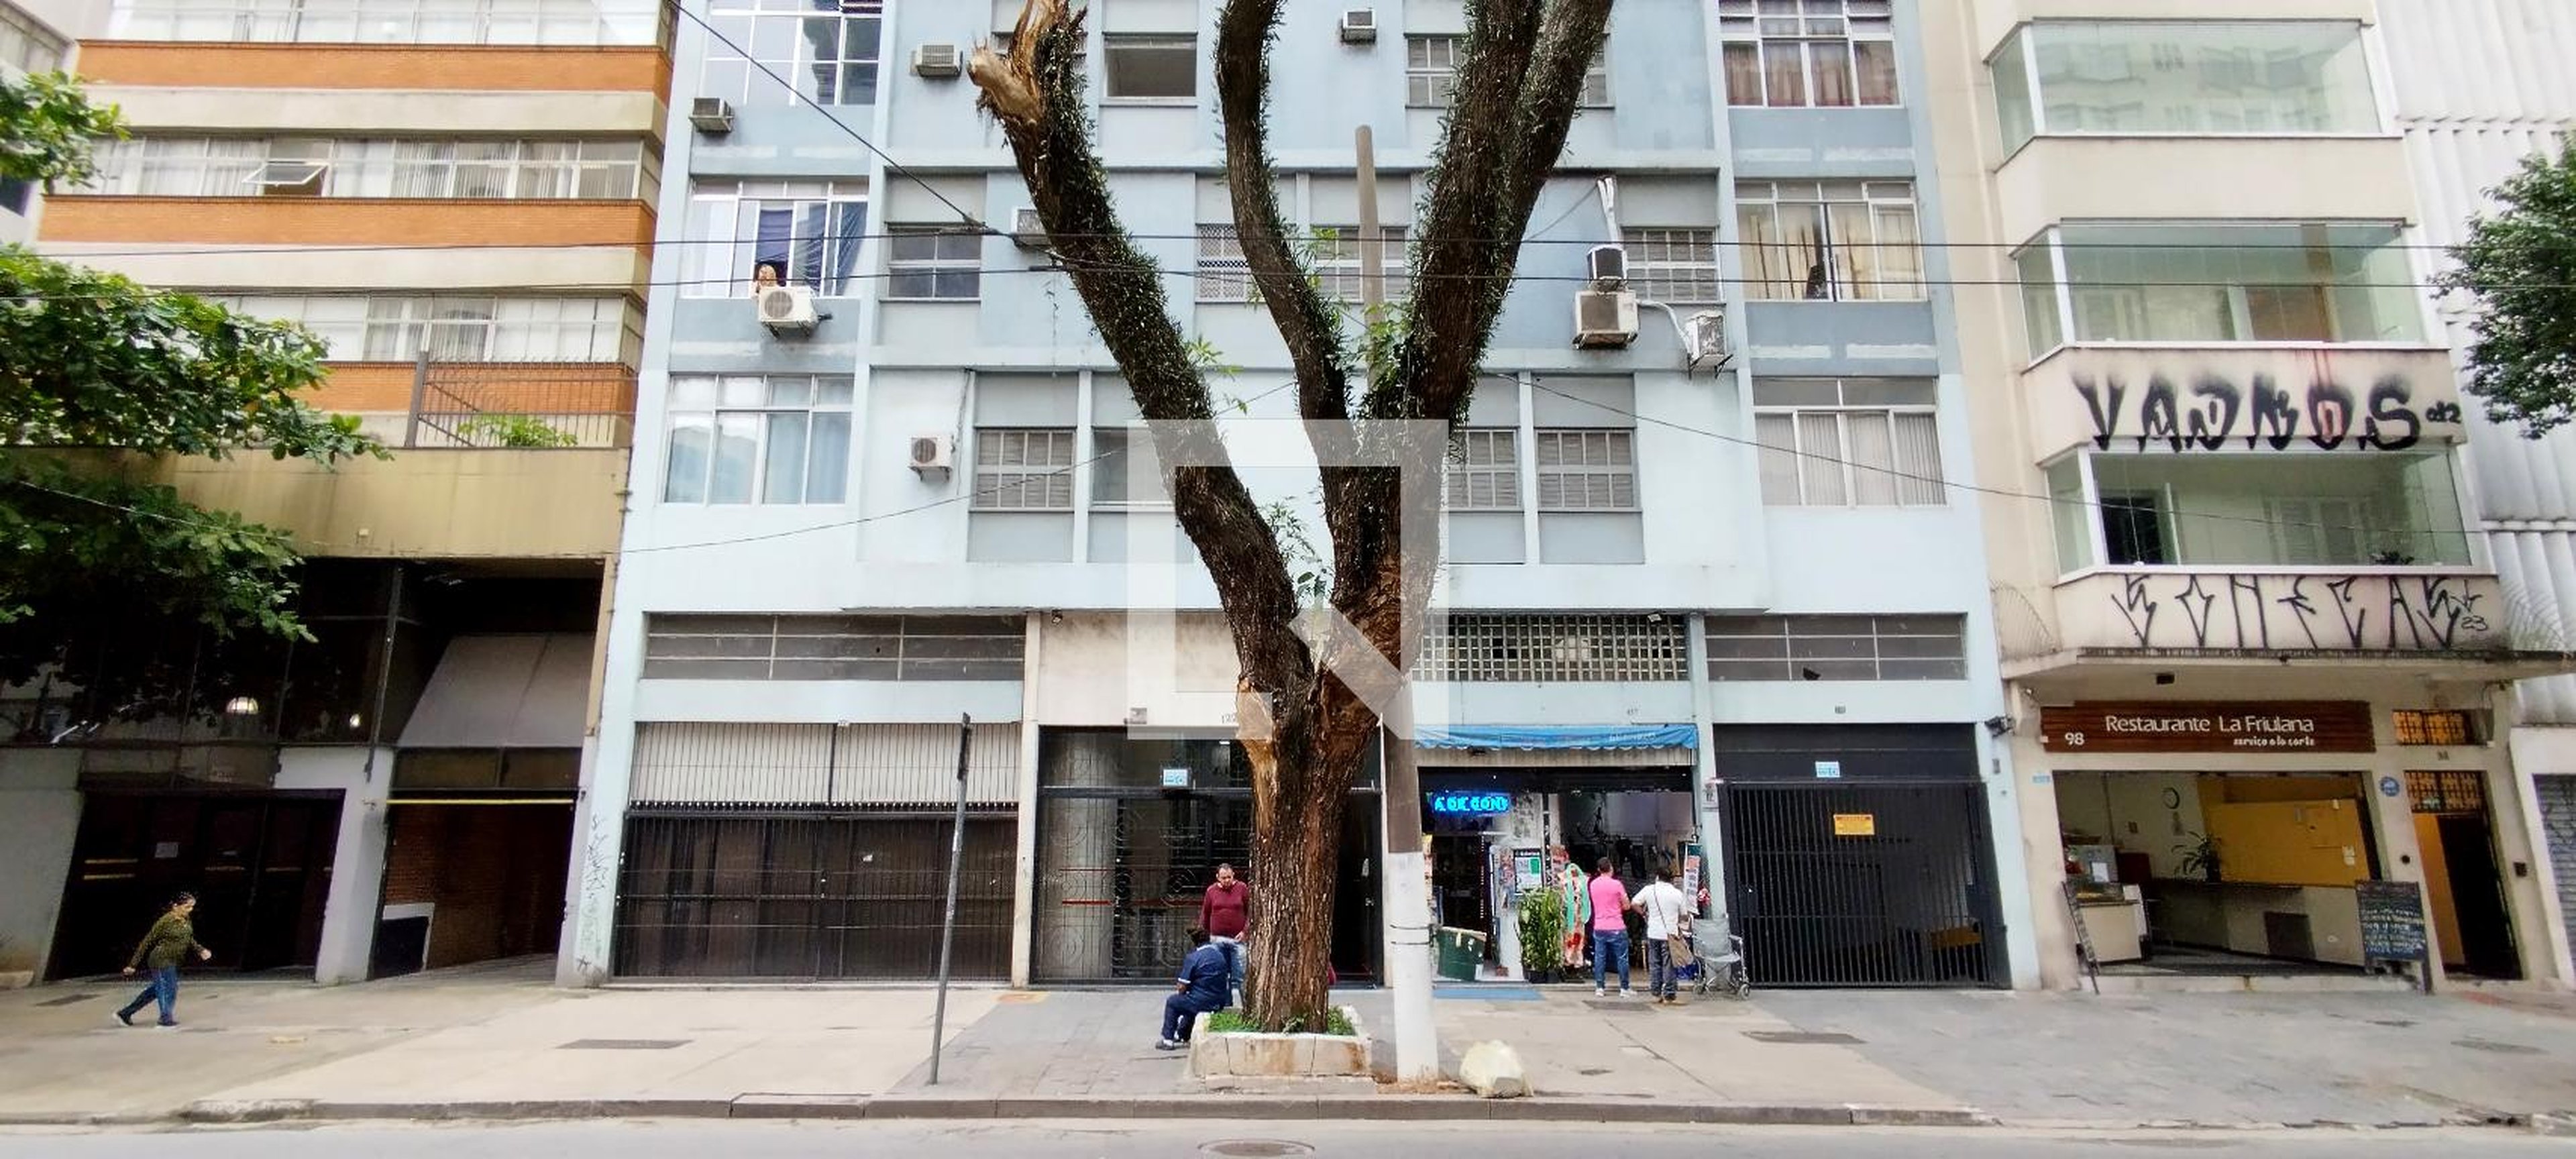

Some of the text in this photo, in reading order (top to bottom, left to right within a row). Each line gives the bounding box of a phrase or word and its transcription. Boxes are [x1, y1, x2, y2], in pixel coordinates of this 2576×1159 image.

[2106, 715, 2314, 732] Restaurante La Friulana
[2065, 732, 2084, 746] 98
